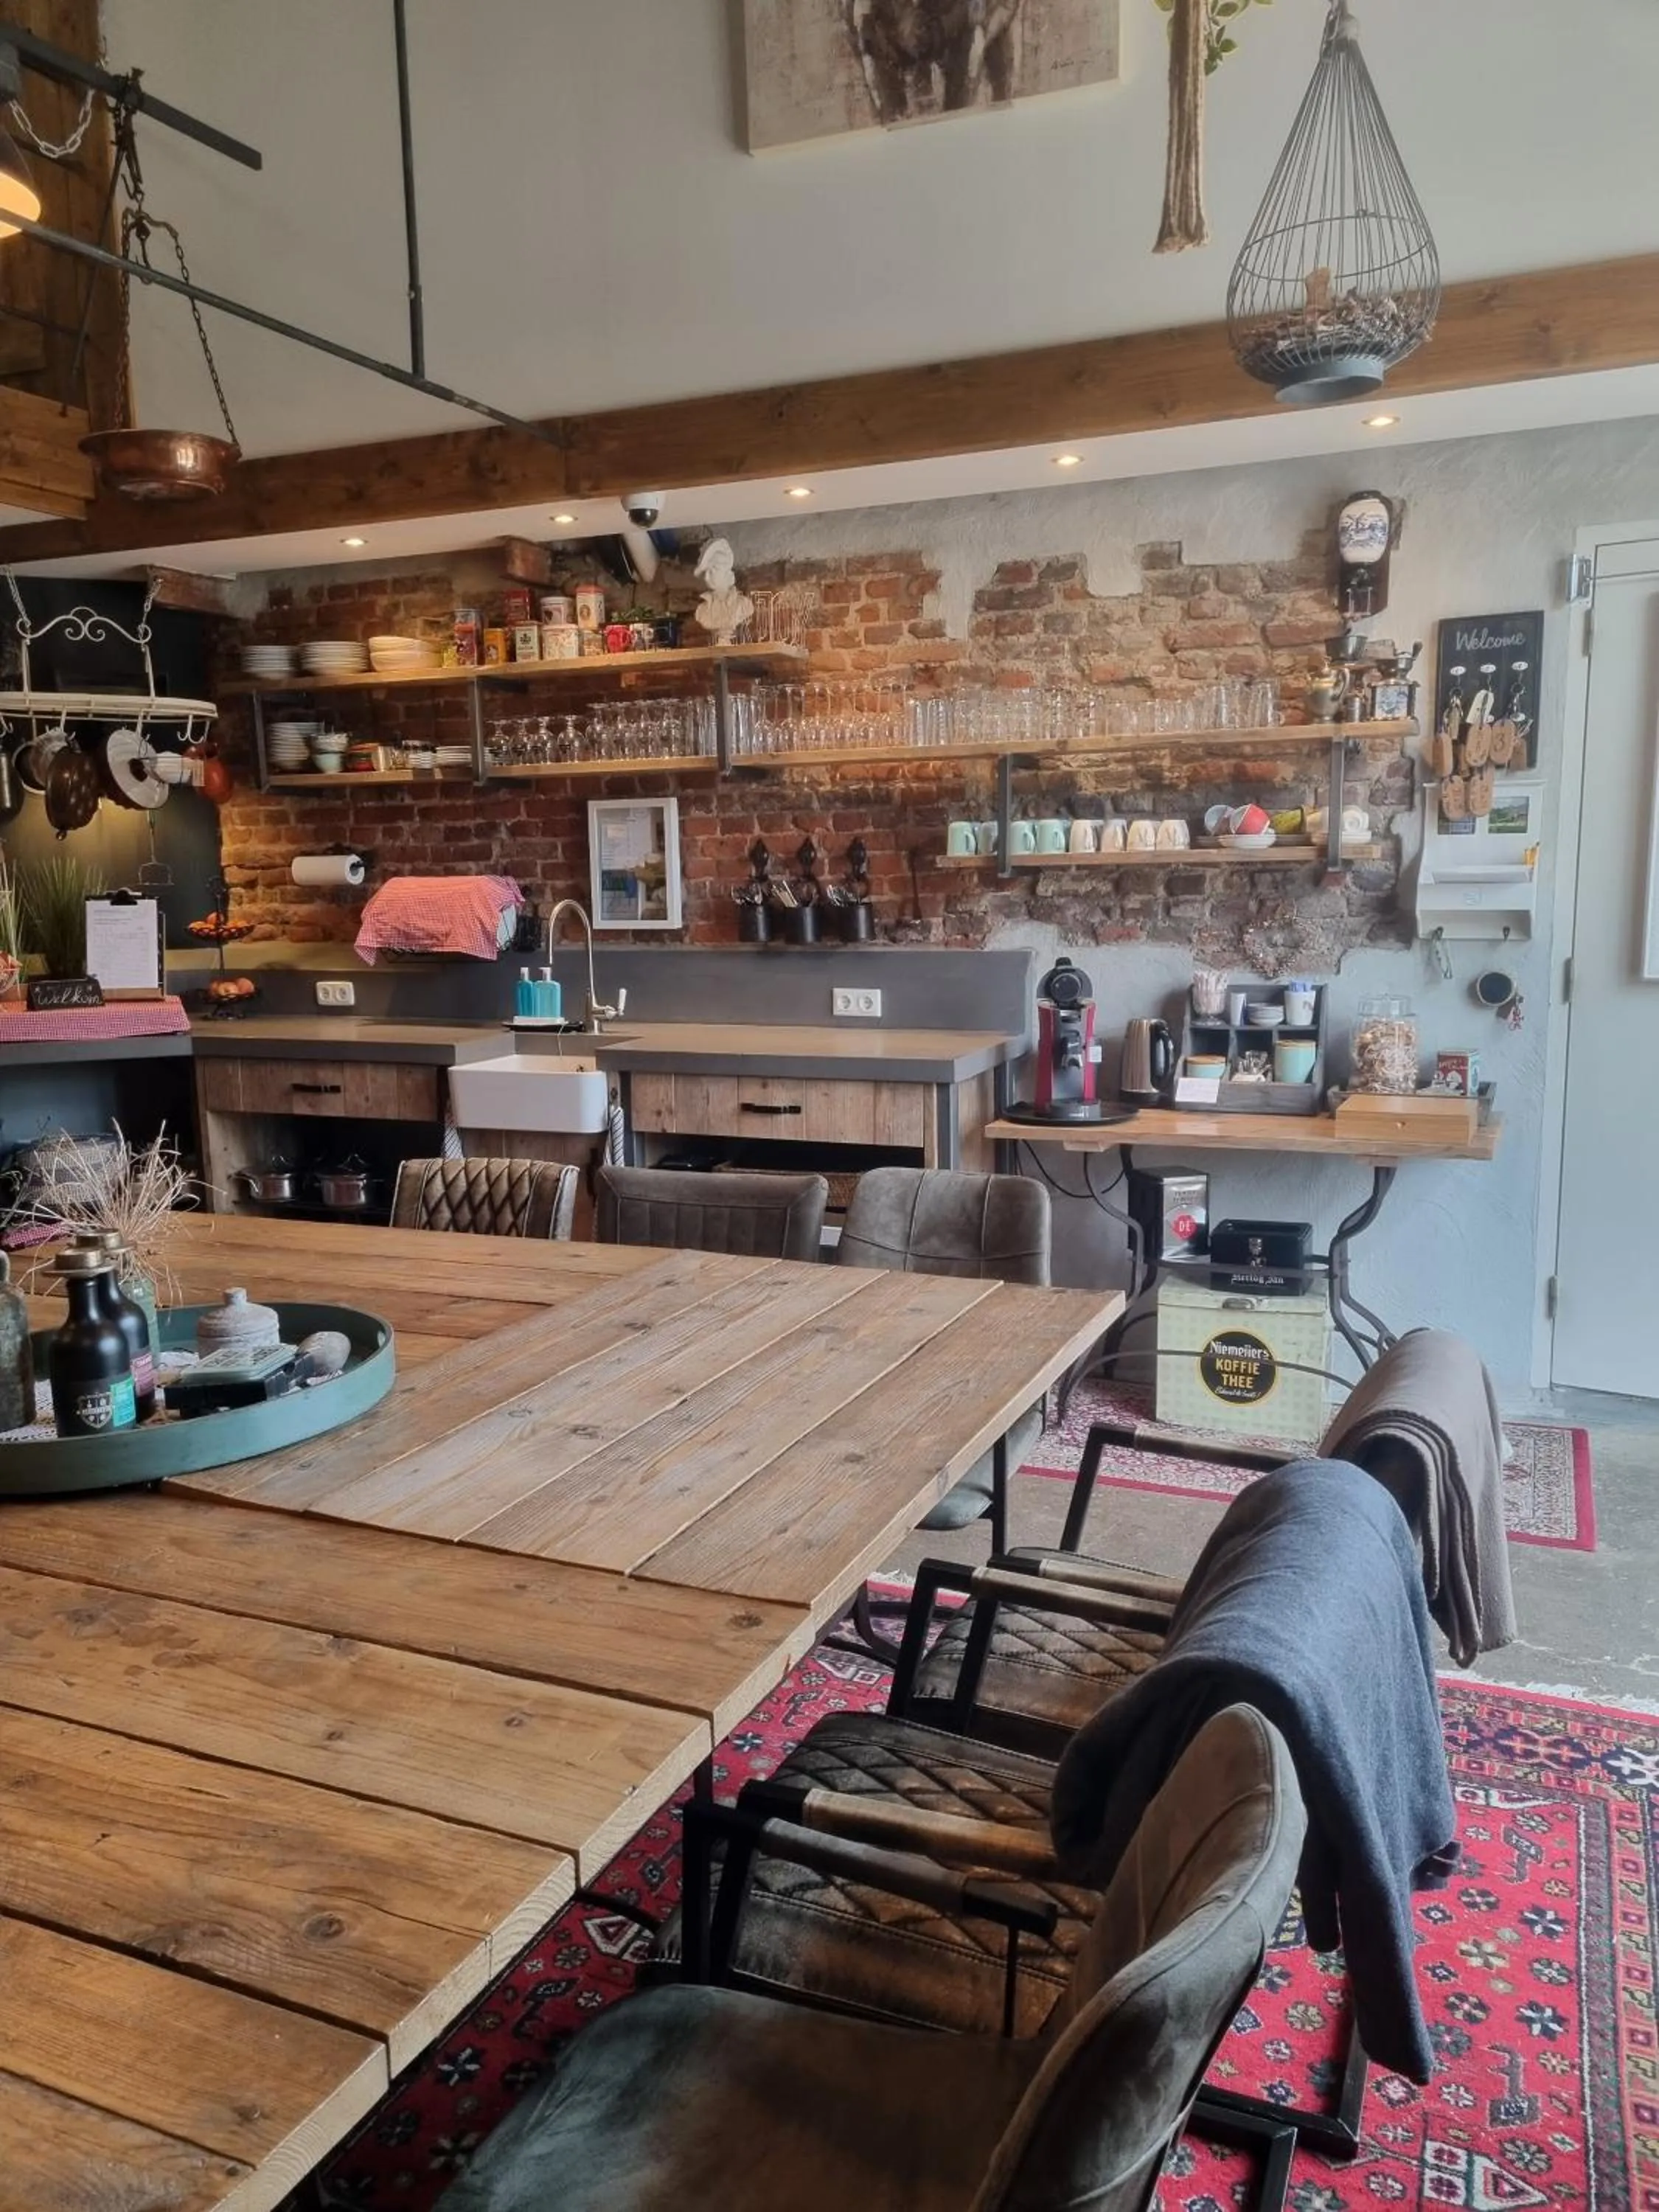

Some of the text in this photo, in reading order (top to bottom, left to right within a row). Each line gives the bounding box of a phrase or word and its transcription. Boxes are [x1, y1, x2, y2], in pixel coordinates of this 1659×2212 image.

[1455, 627, 1526, 650] Welcome
[1215, 1357, 1260, 1375] KOFFIE
[1222, 1374, 1253, 1388] THEE
